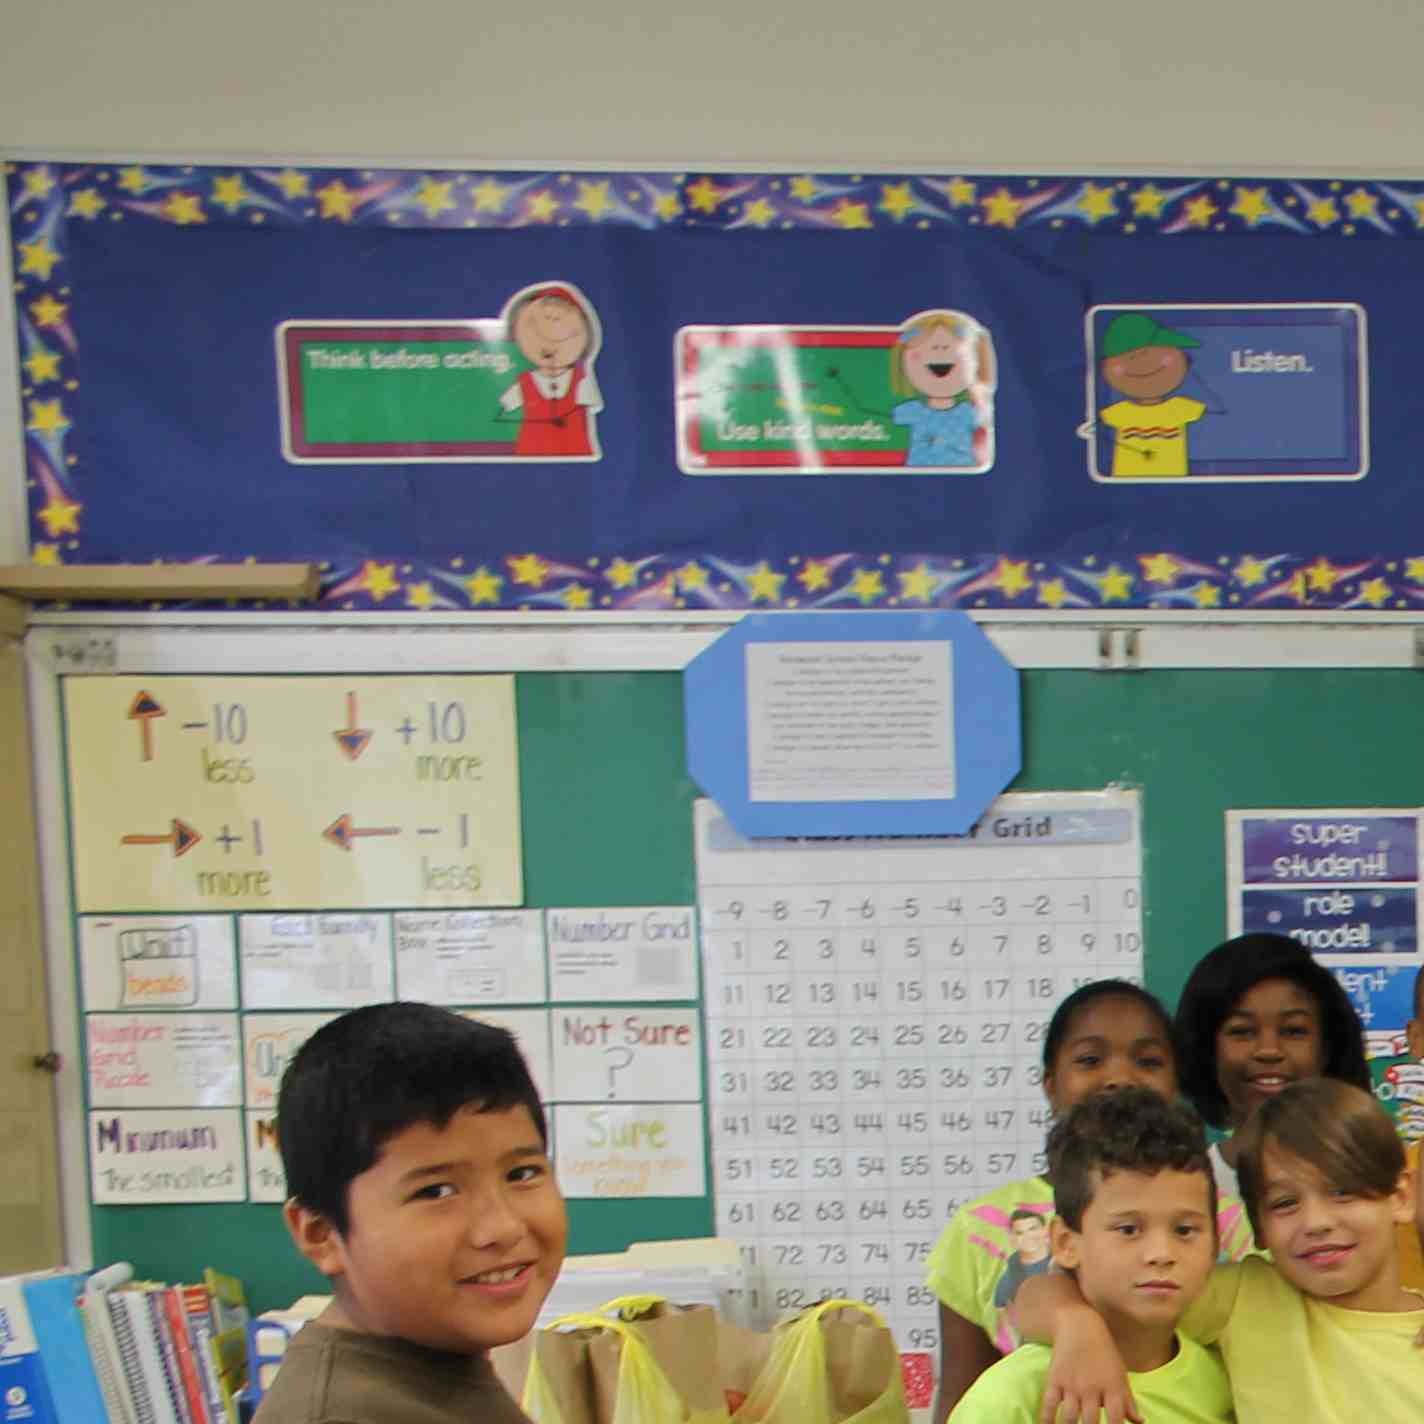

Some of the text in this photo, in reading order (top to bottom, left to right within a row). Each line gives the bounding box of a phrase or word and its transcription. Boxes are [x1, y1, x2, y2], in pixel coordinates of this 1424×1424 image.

[305, 347, 517, 374] Think before acting.
[1230, 348, 1314, 376] Listen.
[716, 418, 890, 442] Use kind words.
[202, 748, 255, 784] less
[415, 754, 484, 783] more
[992, 815, 1053, 838] Grid
[1290, 823, 1368, 848] super
[196, 869, 273, 897] more
[421, 856, 481, 891] less
[1123, 888, 1137, 909] 0
[1304, 891, 1356, 917] role
[551, 911, 691, 943] Number Grid
[733, 933, 1140, 960] 1 2 3 4 5 6 7 8 9 10
[723, 978, 1054, 1004] 11 12 13 14 15 16 17 18
[563, 1015, 692, 1047] Not Sure
[586, 1109, 669, 1149] Sure
[775, 1242, 931, 1265] 72 73 74 75
[863, 1285, 936, 1305] 84 85
